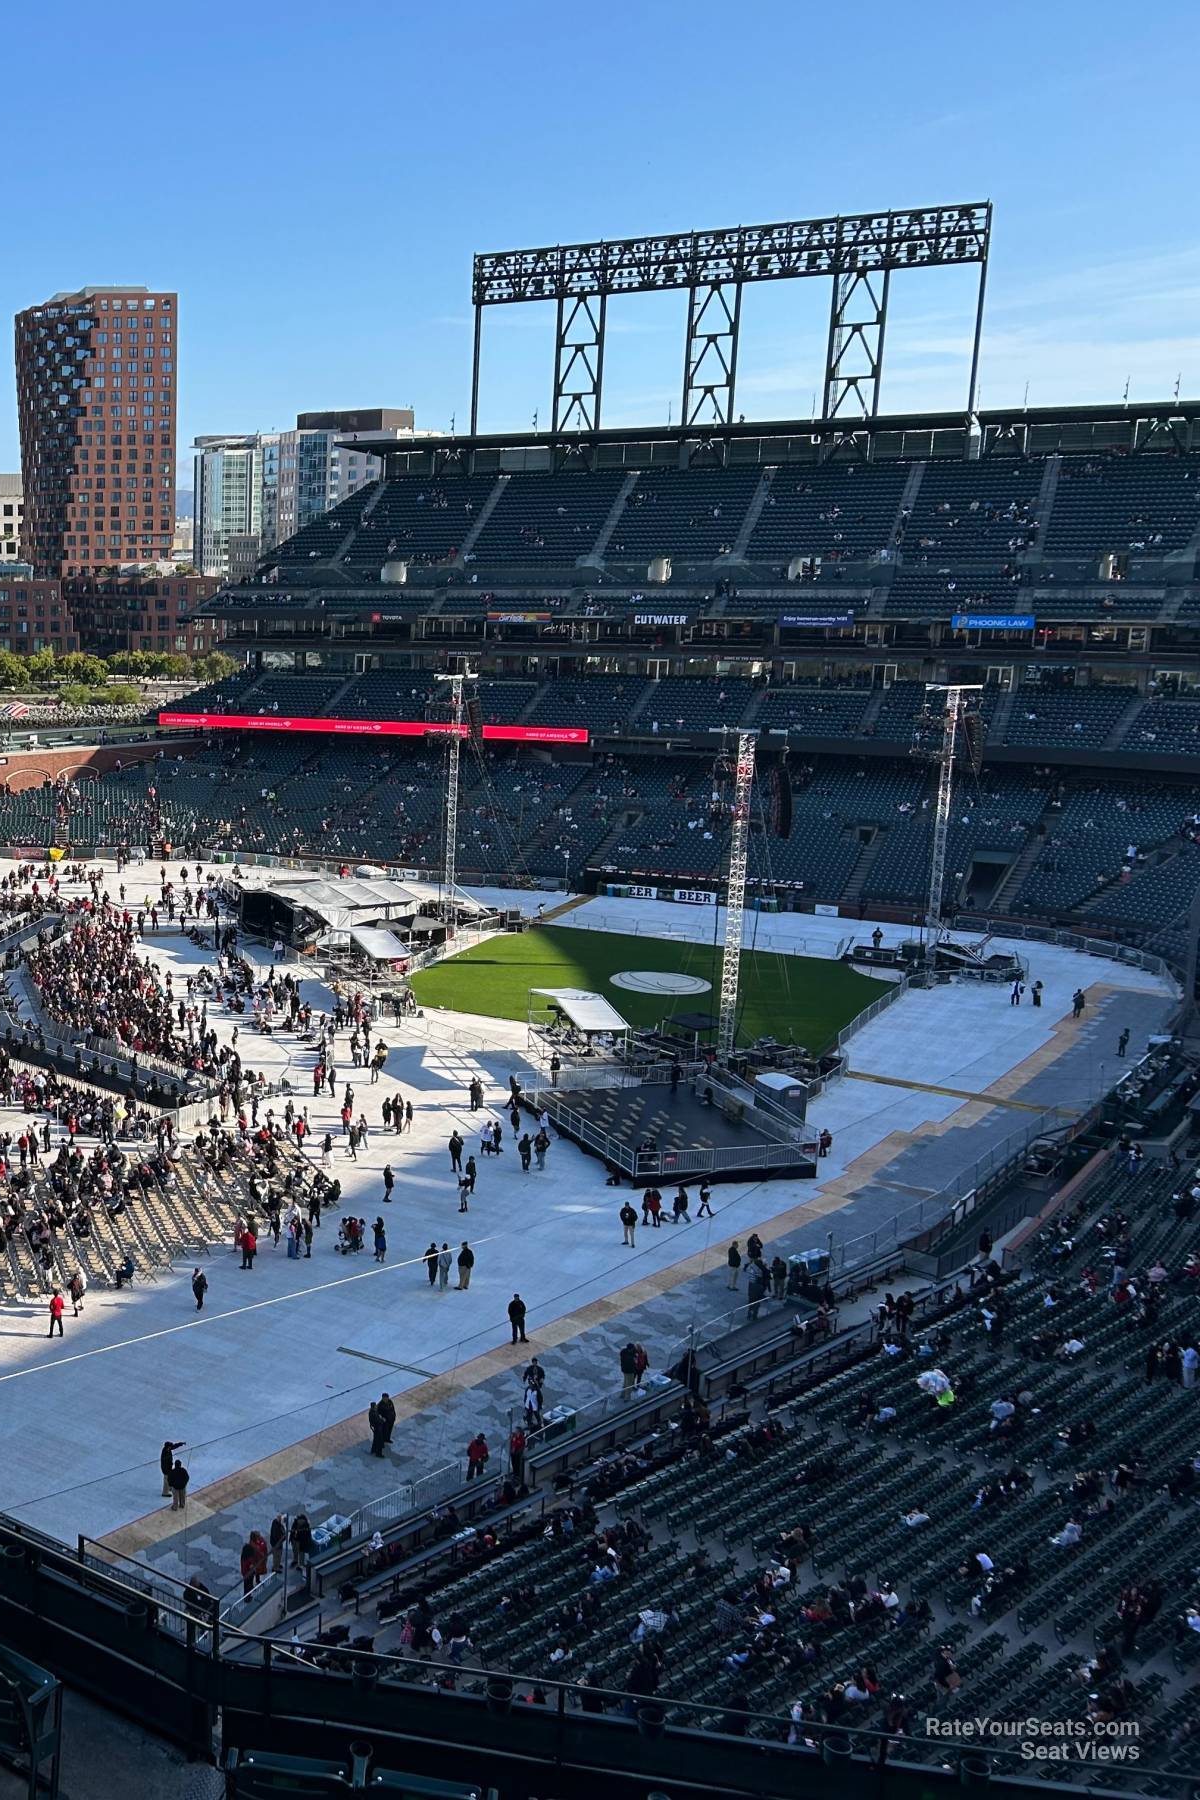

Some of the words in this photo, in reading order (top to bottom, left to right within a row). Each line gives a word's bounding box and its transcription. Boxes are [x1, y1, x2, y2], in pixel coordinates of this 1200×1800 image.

[634, 615, 687, 625] CUTWATER
[969, 619, 1007, 627] PHOONG
[628, 886, 652, 897] EER
[679, 890, 711, 903] BEER
